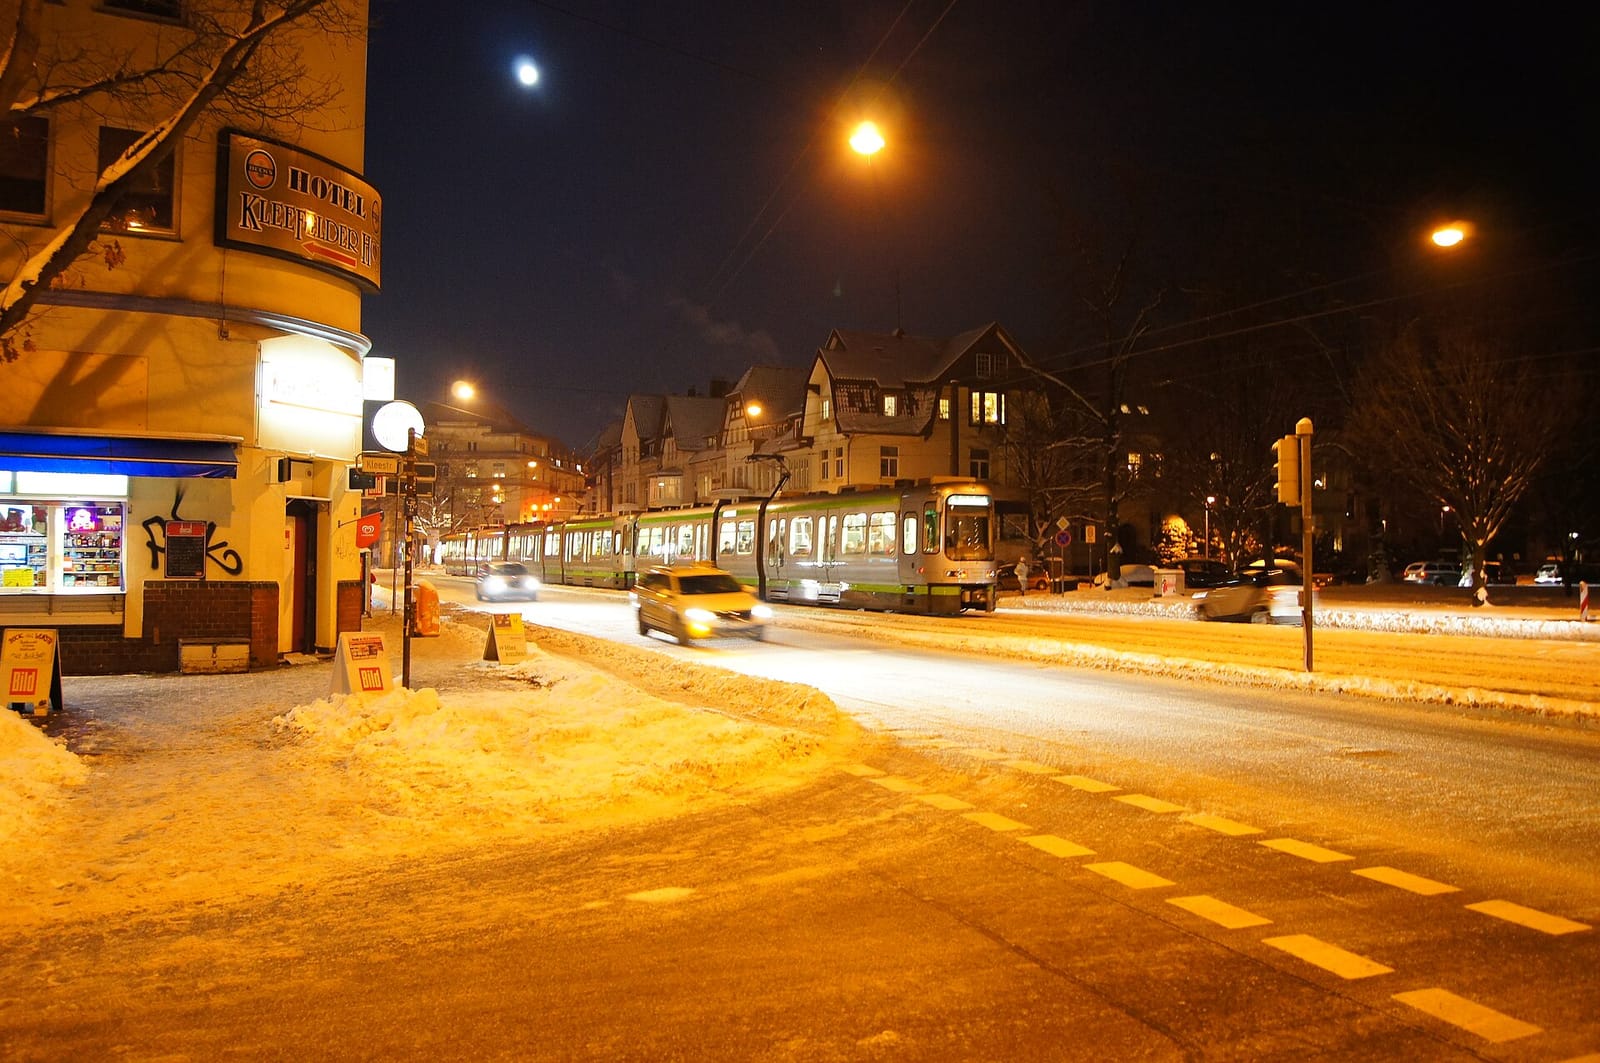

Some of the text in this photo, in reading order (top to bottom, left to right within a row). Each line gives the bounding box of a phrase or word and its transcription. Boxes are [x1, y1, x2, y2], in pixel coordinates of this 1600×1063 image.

[288, 166, 367, 220] HOTEL
[239, 191, 359, 254] KLEEFELDER
[11, 671, 36, 693] Bild
[360, 669, 382, 689] Bild
